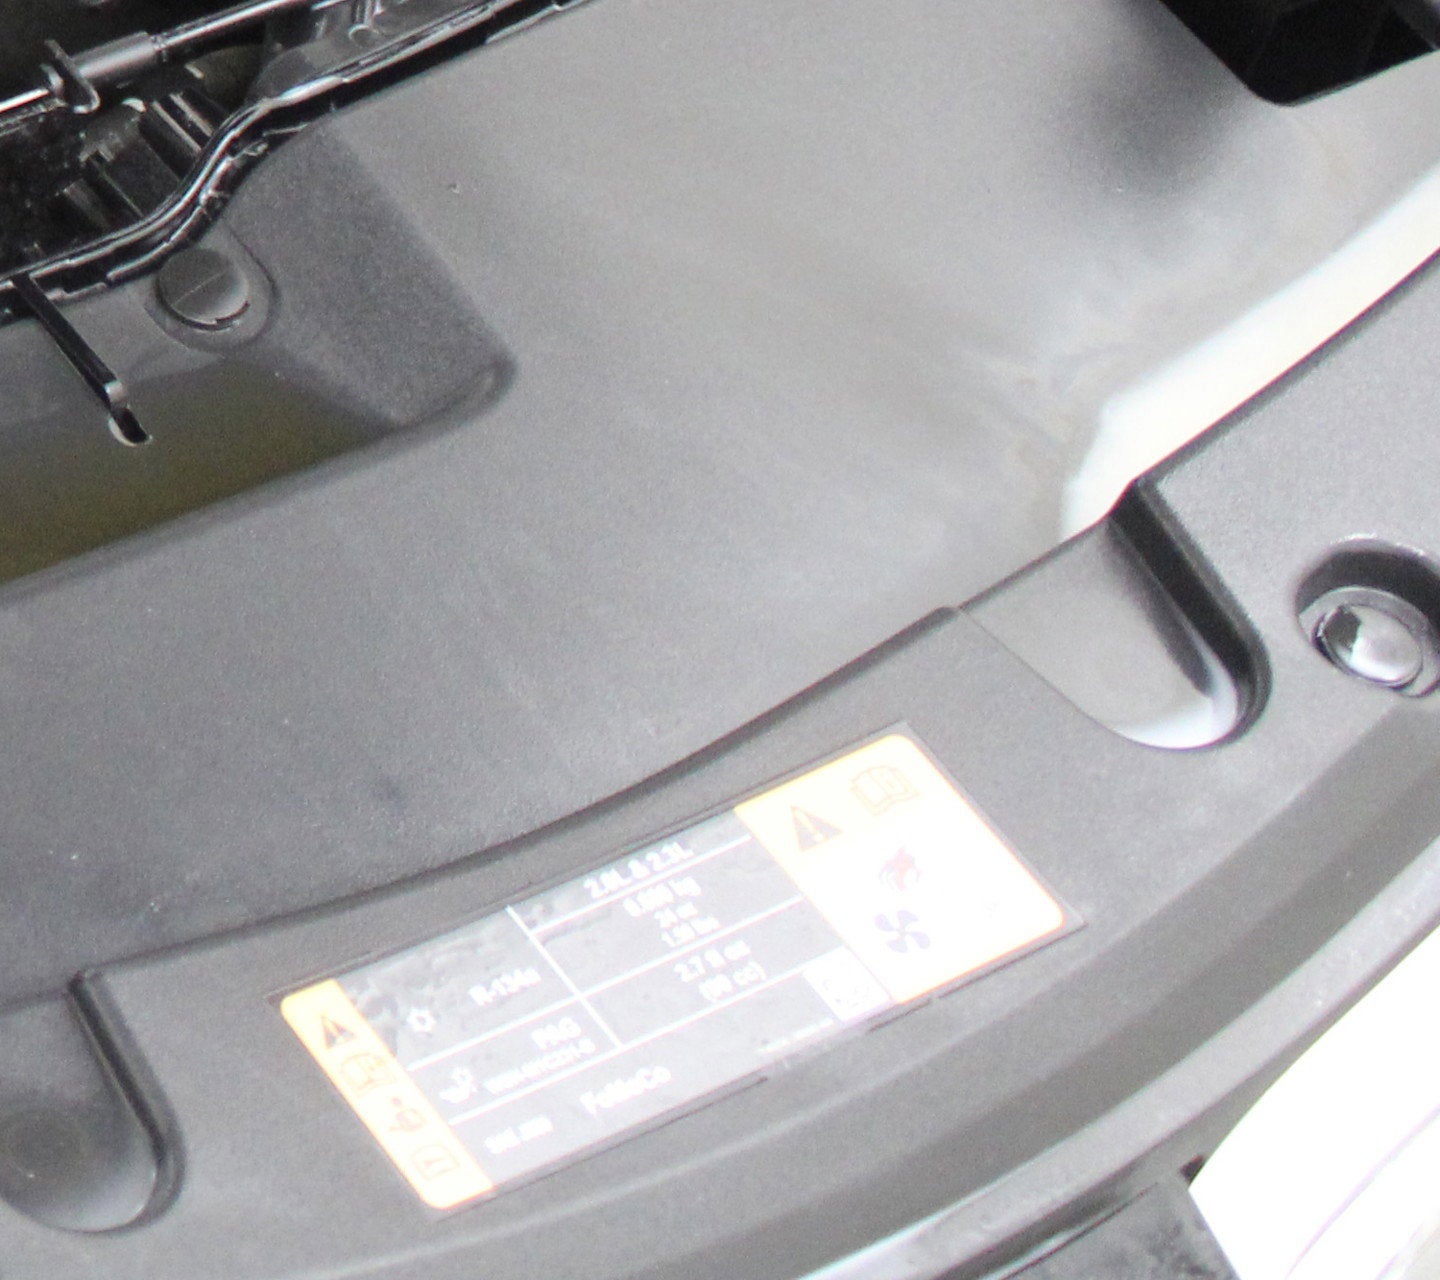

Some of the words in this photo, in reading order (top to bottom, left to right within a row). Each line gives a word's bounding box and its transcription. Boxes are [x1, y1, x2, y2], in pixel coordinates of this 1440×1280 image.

[646, 842, 693, 870] 2.3L
[529, 1016, 581, 1049] PAG
[578, 1065, 671, 1115] FoMoCo
